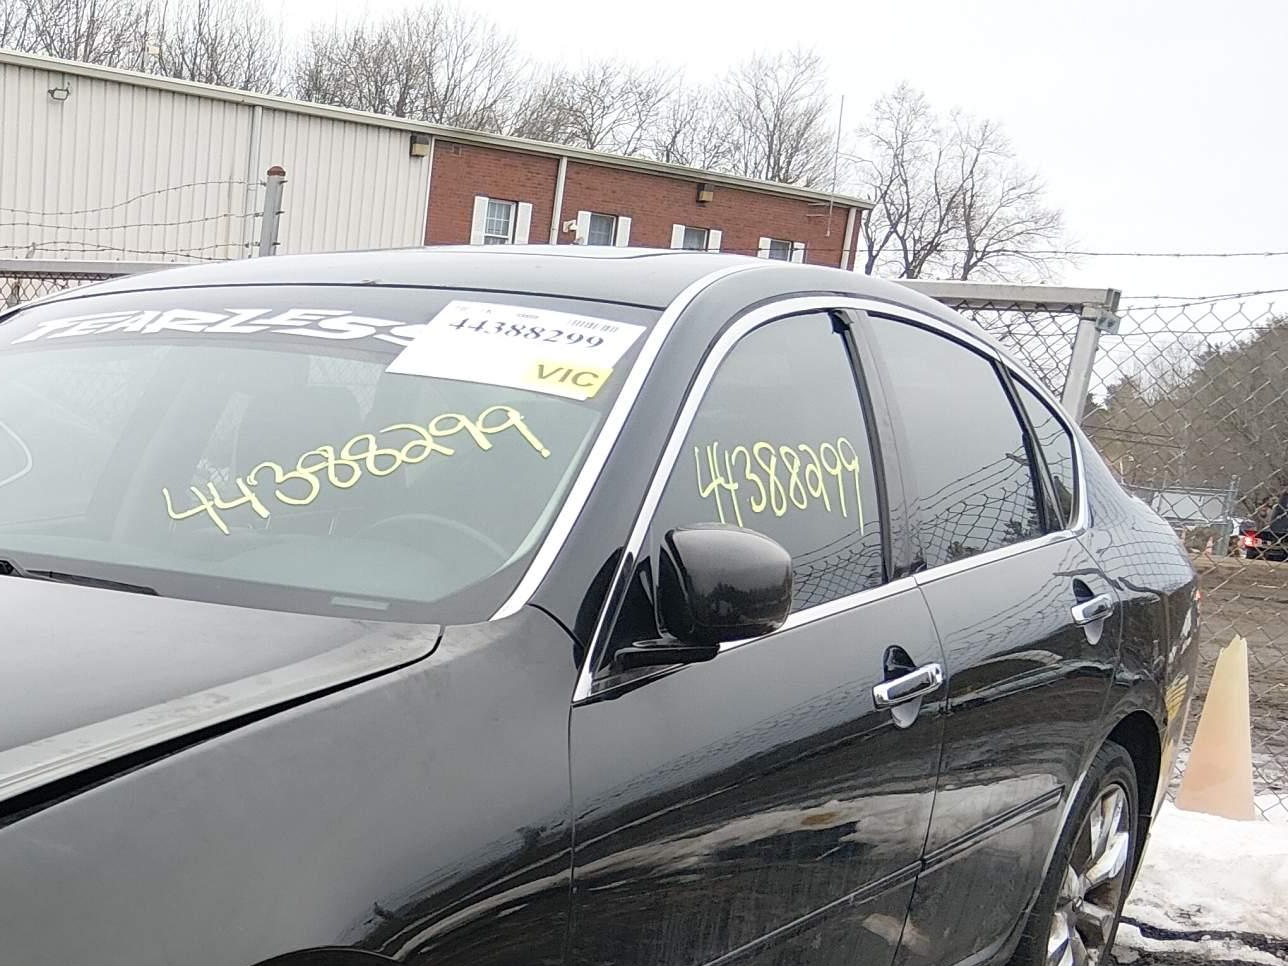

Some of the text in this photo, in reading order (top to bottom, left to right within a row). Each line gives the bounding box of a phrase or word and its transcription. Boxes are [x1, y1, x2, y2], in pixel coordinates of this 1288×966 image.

[448, 317, 604, 348] 44388299
[536, 364, 599, 388] VIC
[163, 405, 551, 534] 44388299
[694, 437, 863, 536] 44388299
